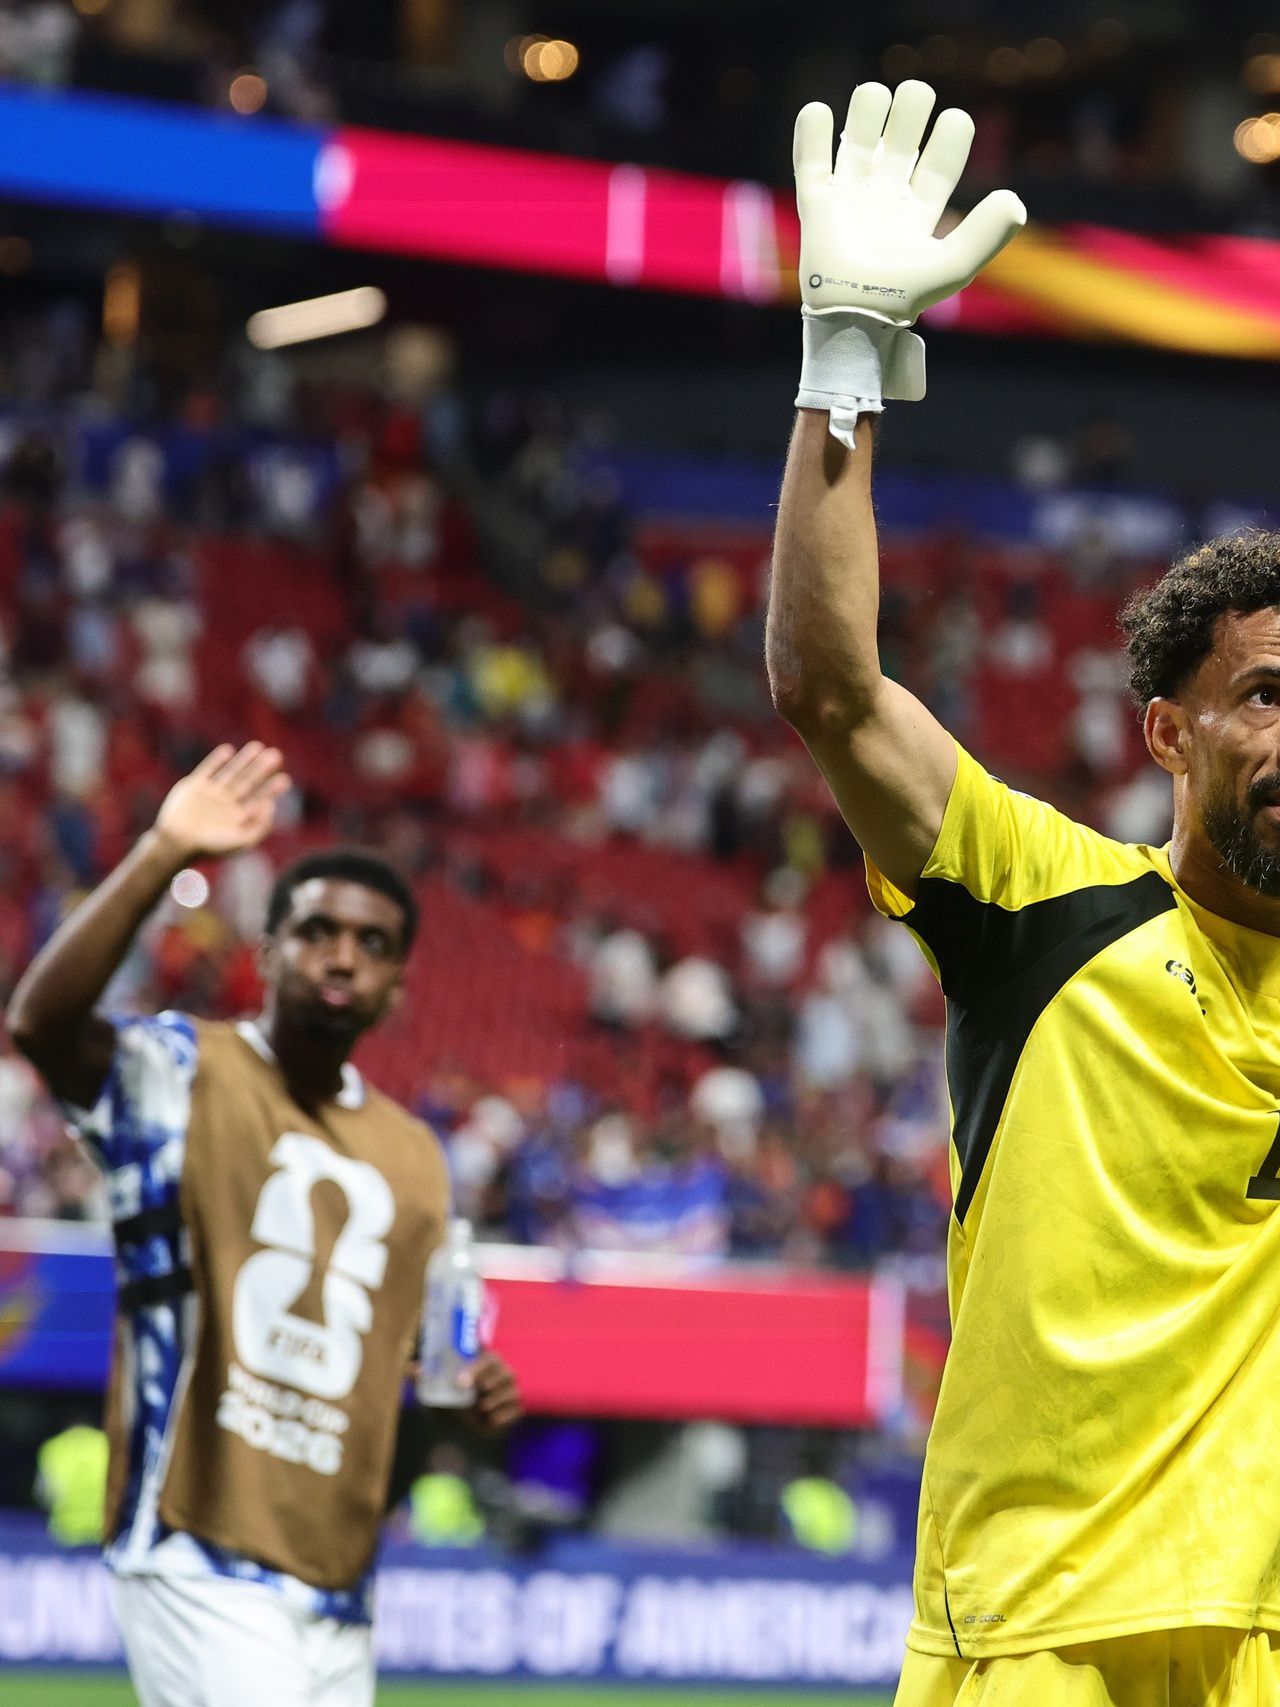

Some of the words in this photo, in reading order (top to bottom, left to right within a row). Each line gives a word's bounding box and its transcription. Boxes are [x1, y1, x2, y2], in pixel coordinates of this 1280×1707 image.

[824, 277, 859, 289] ELITE
[862, 284, 906, 296] SPORT
[216, 1390, 343, 1476] 2026
